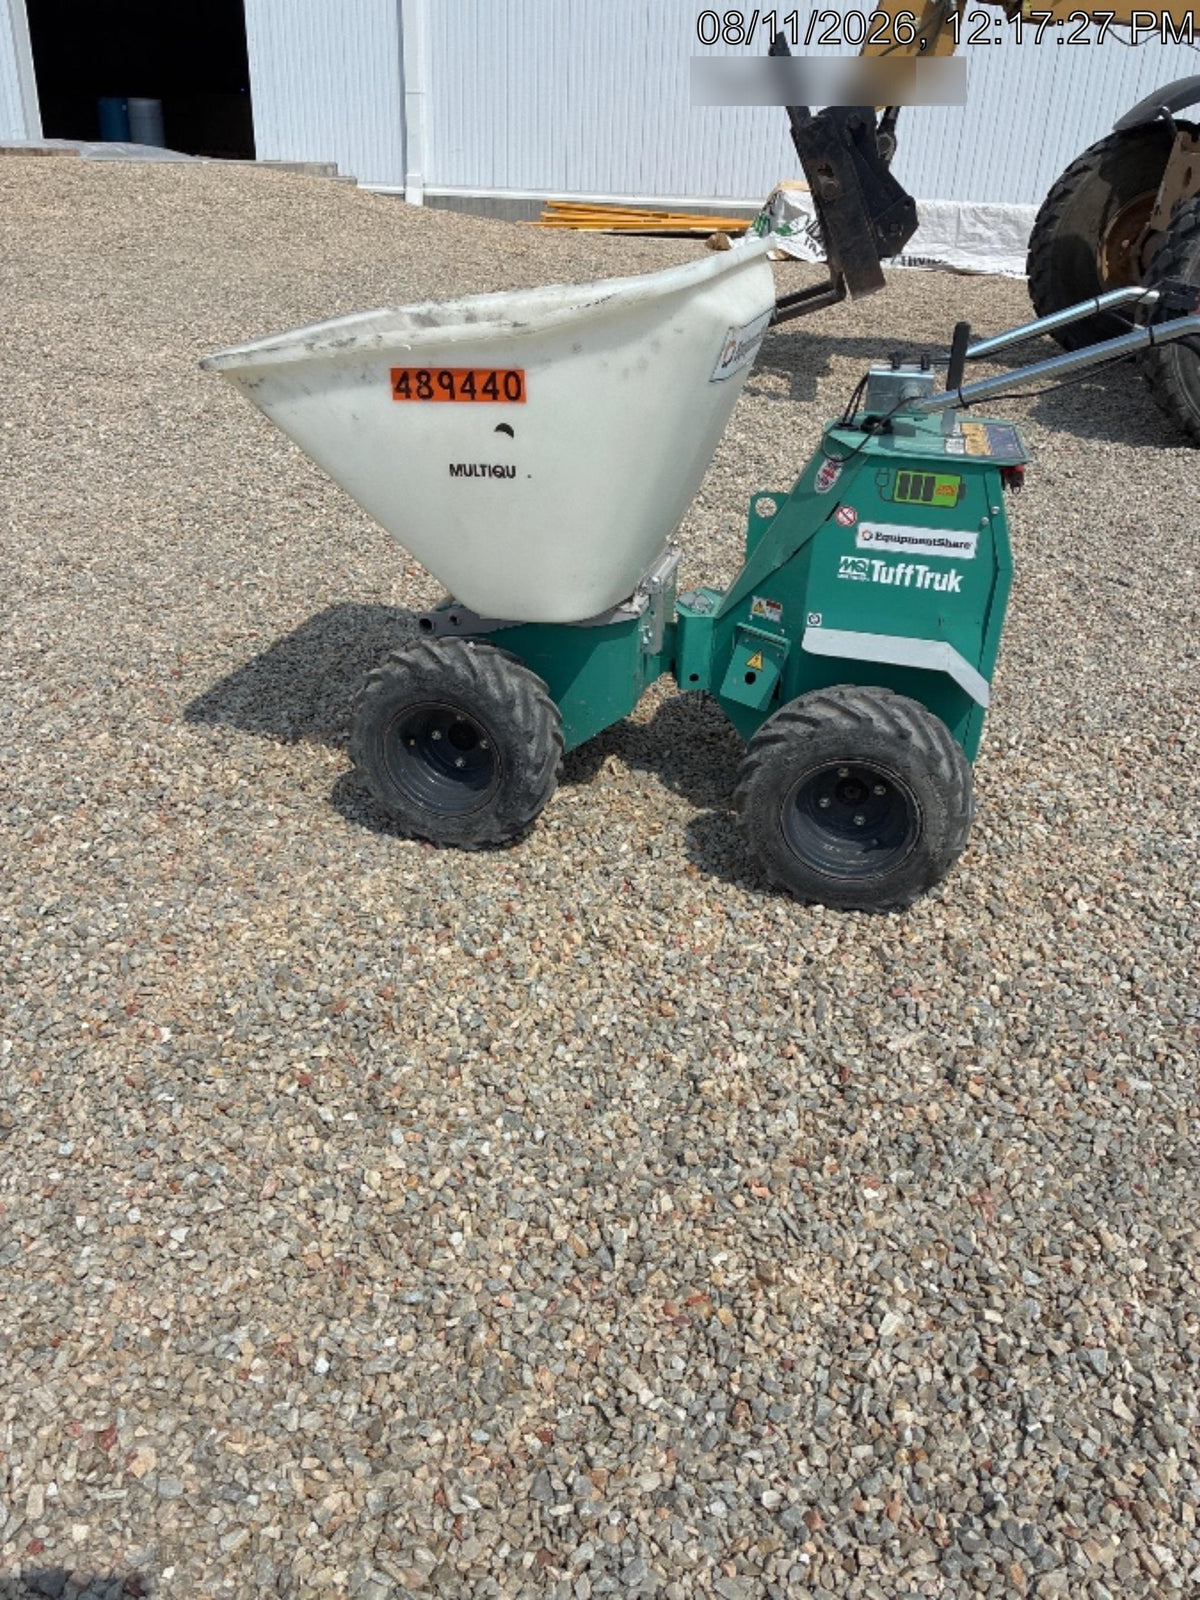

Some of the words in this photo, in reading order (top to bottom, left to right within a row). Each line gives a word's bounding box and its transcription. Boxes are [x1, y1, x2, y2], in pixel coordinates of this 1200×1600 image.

[395, 370, 522, 401] 489440
[449, 463, 516, 479] MULTIQU
[875, 531, 972, 550] EquipmentShare
[871, 559, 964, 593] TuffTruk
